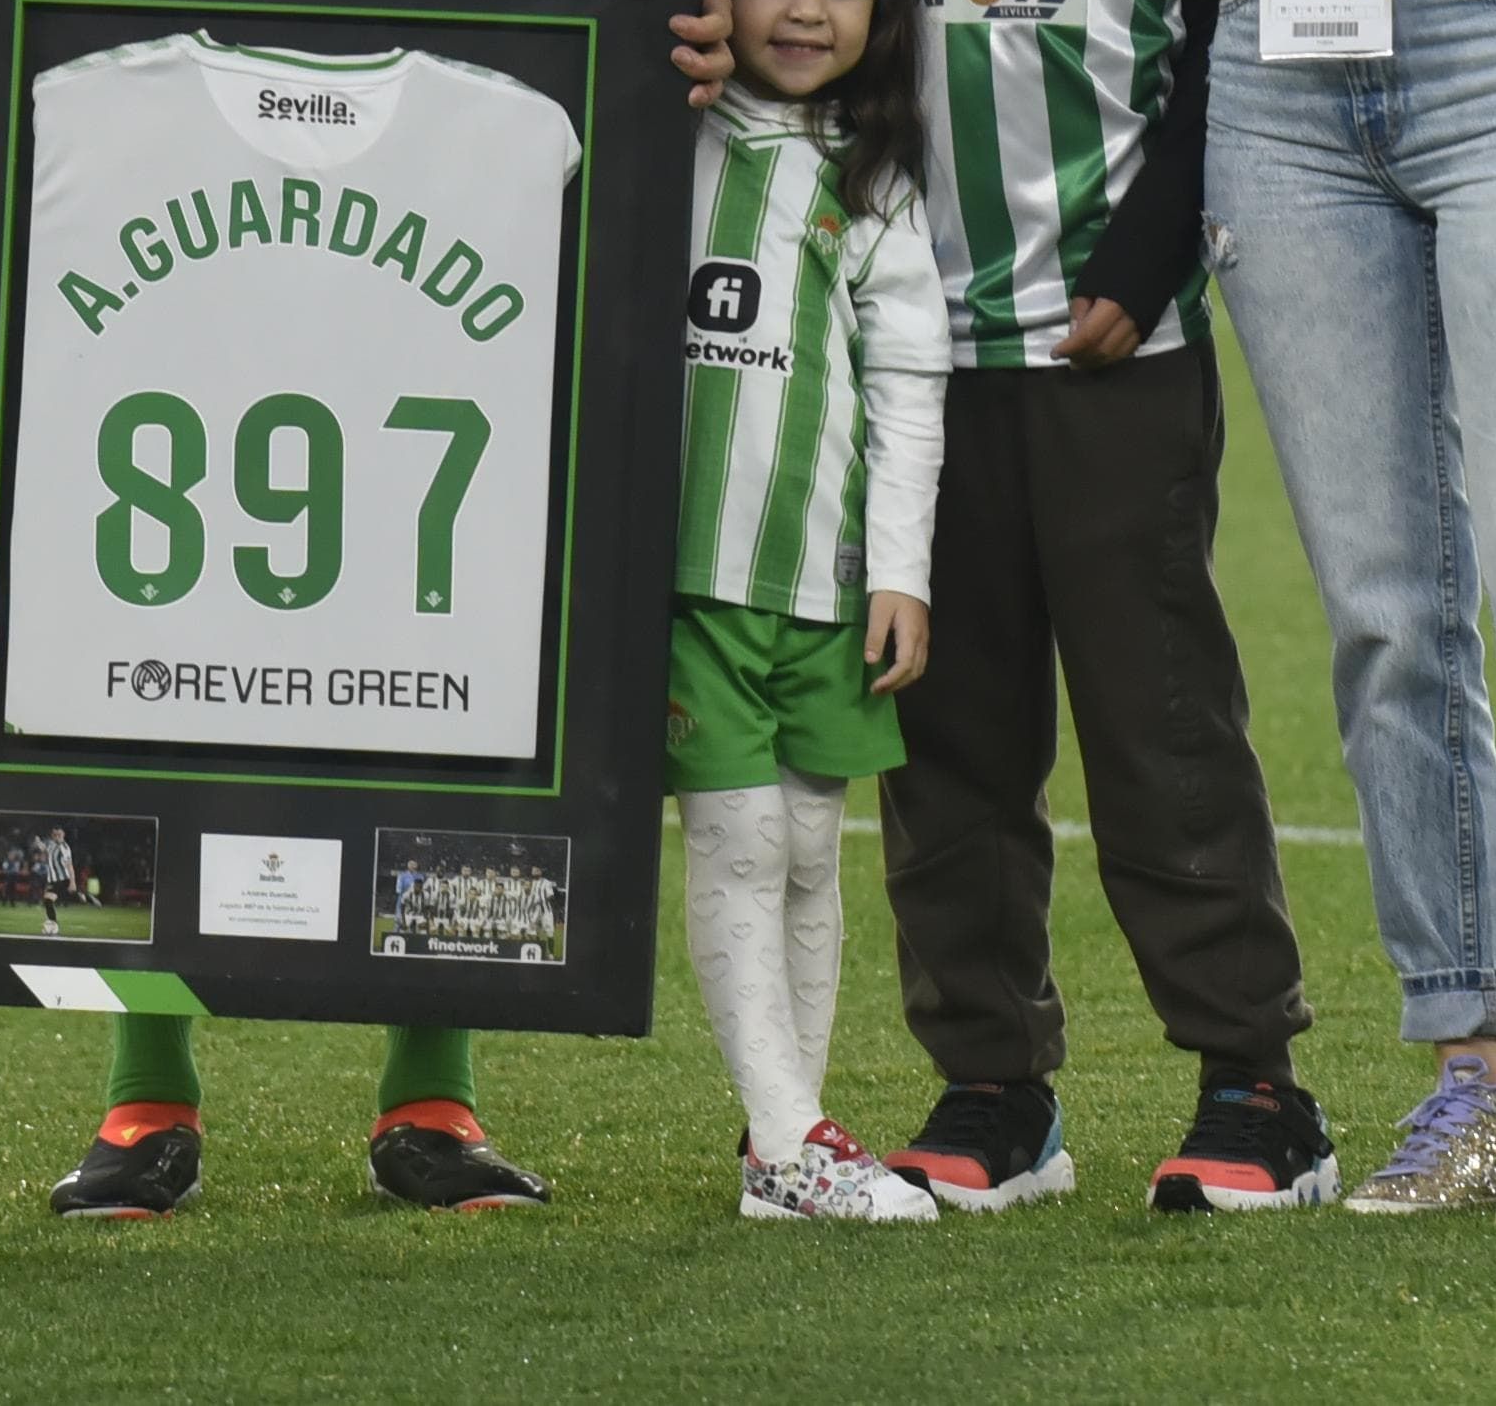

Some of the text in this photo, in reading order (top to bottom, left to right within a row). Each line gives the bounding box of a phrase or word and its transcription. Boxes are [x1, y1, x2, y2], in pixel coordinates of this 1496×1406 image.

[999, 6, 1042, 18] SEVILLA
[57, 177, 524, 343] A.GUARDADO
[95, 390, 493, 616] 897
[107, 658, 469, 712] FOREVER GREEN
[427, 937, 499, 955] finetwork
